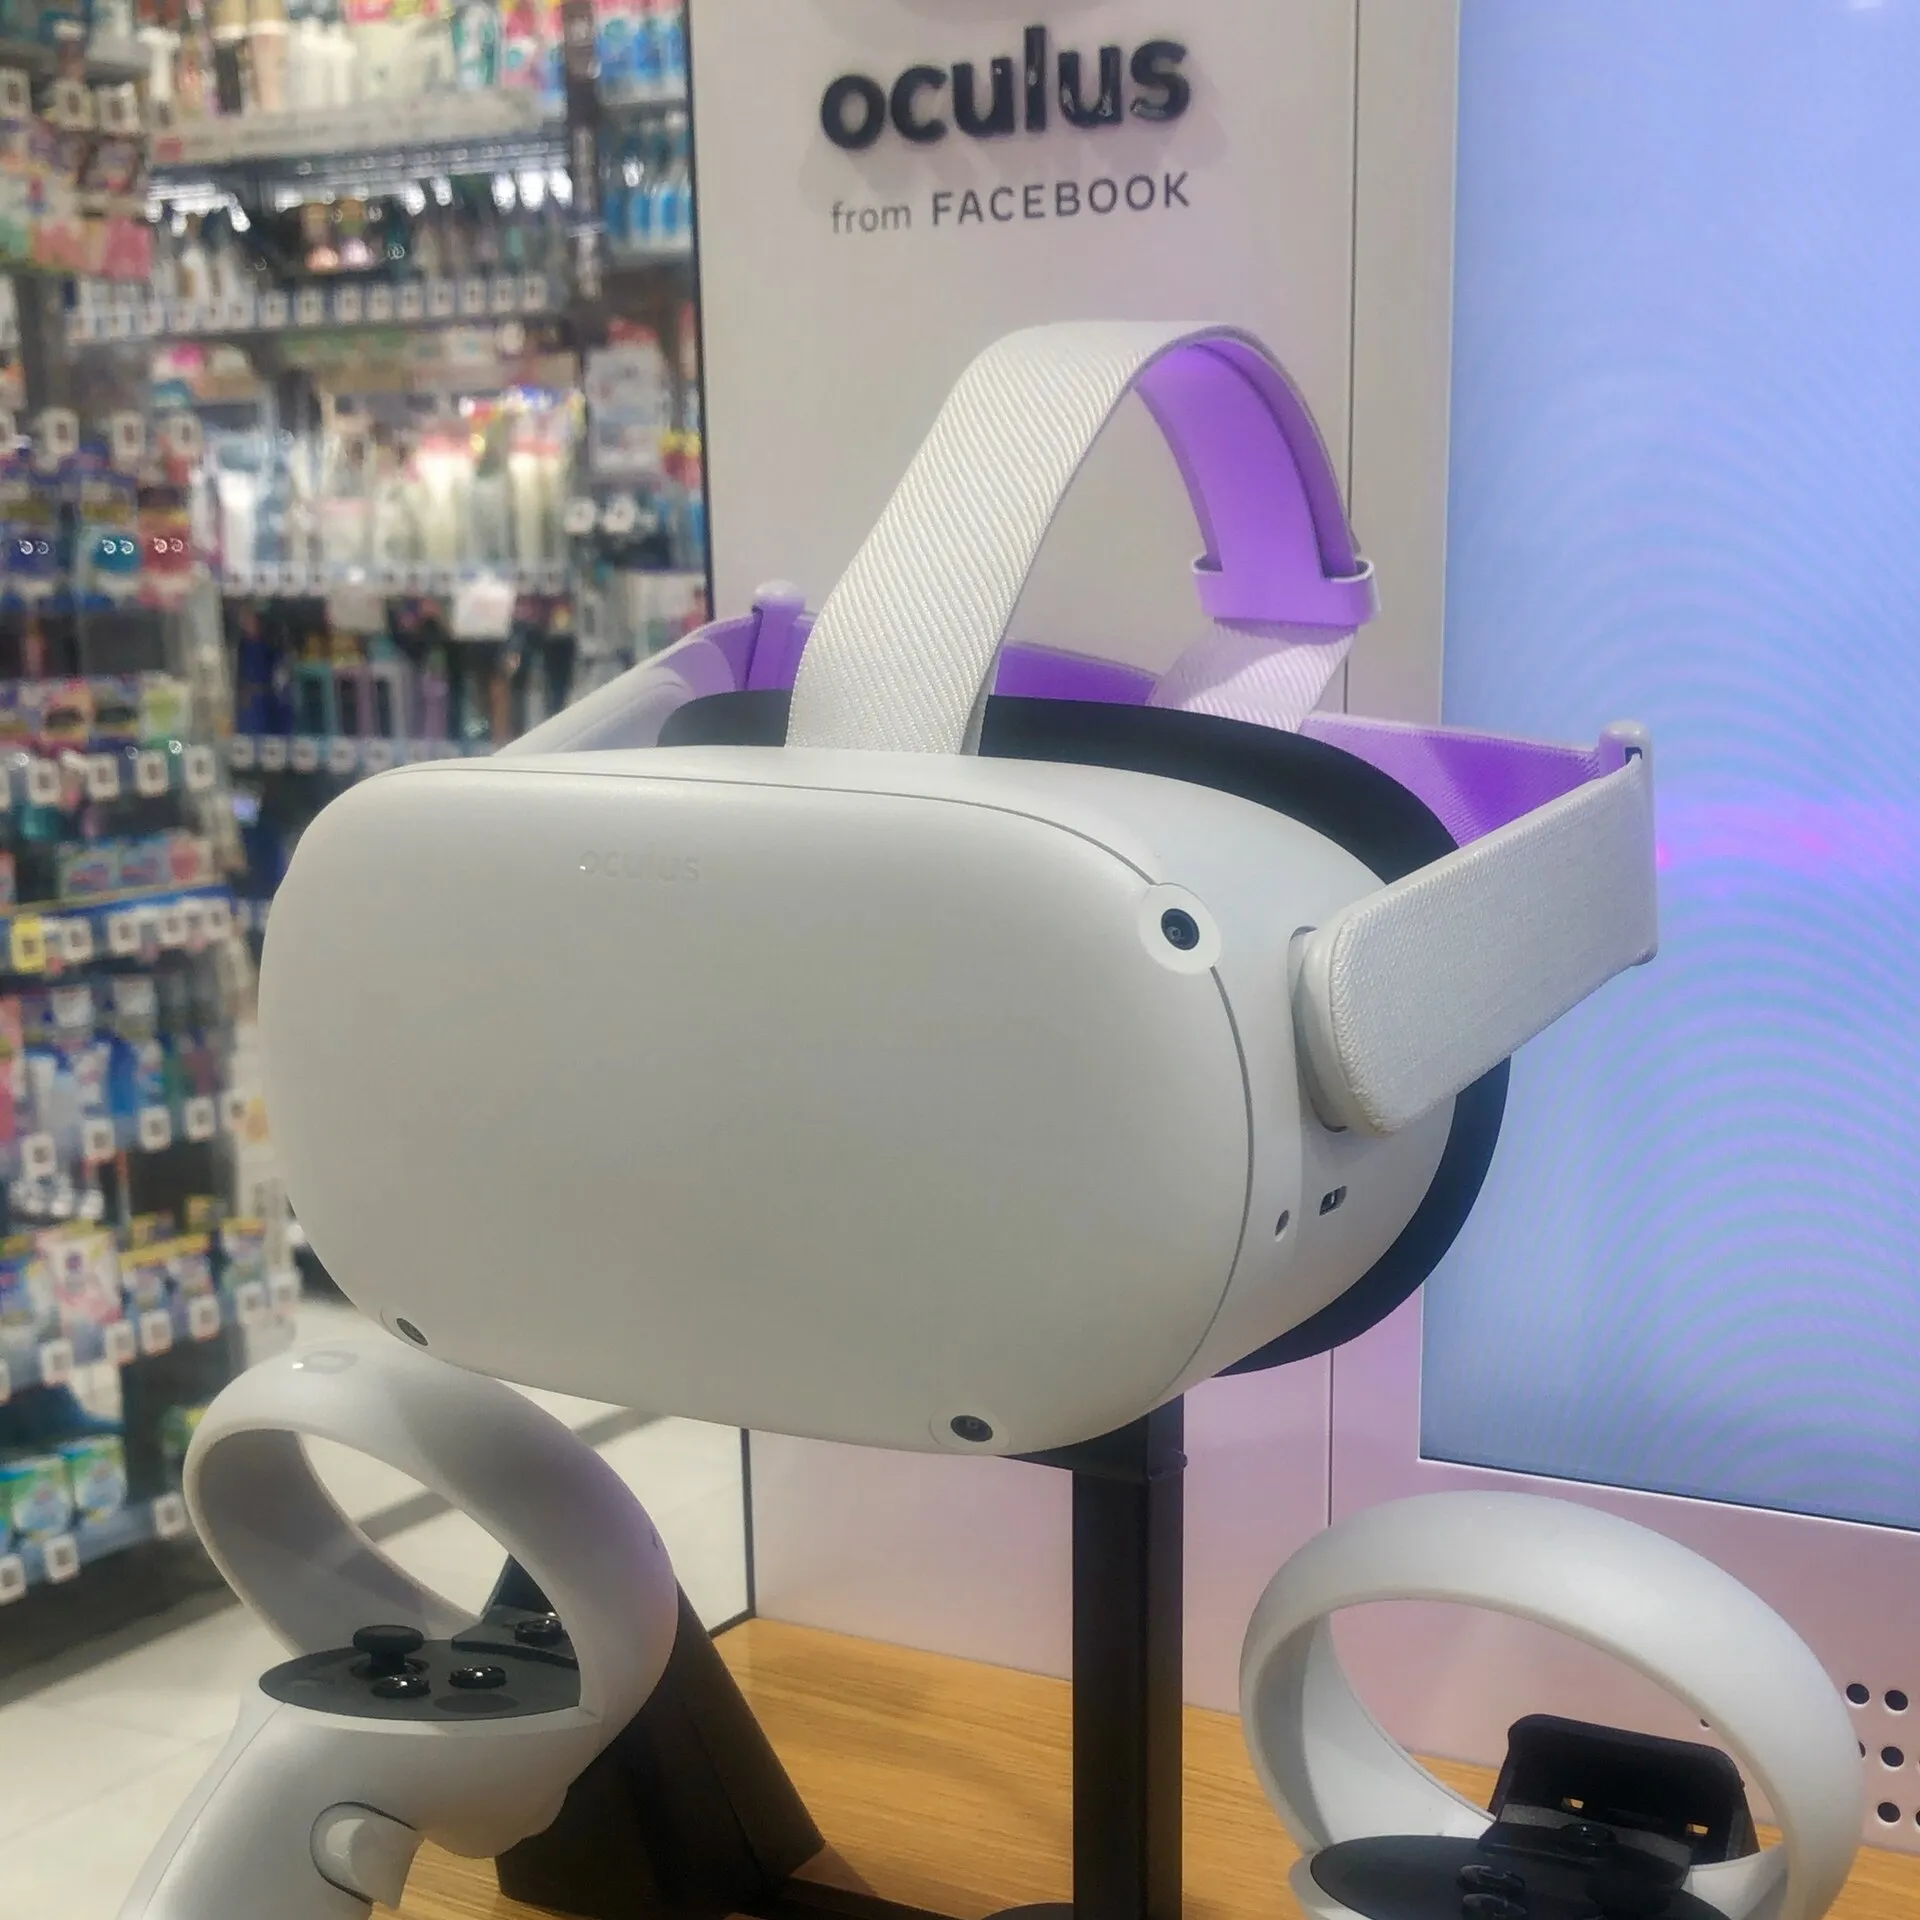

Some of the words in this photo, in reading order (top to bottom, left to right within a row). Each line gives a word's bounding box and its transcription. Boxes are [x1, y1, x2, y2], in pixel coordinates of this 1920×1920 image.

[821, 25, 1191, 150] oculus
[831, 201, 912, 234] from
[932, 171, 1191, 227] FACEBOOK
